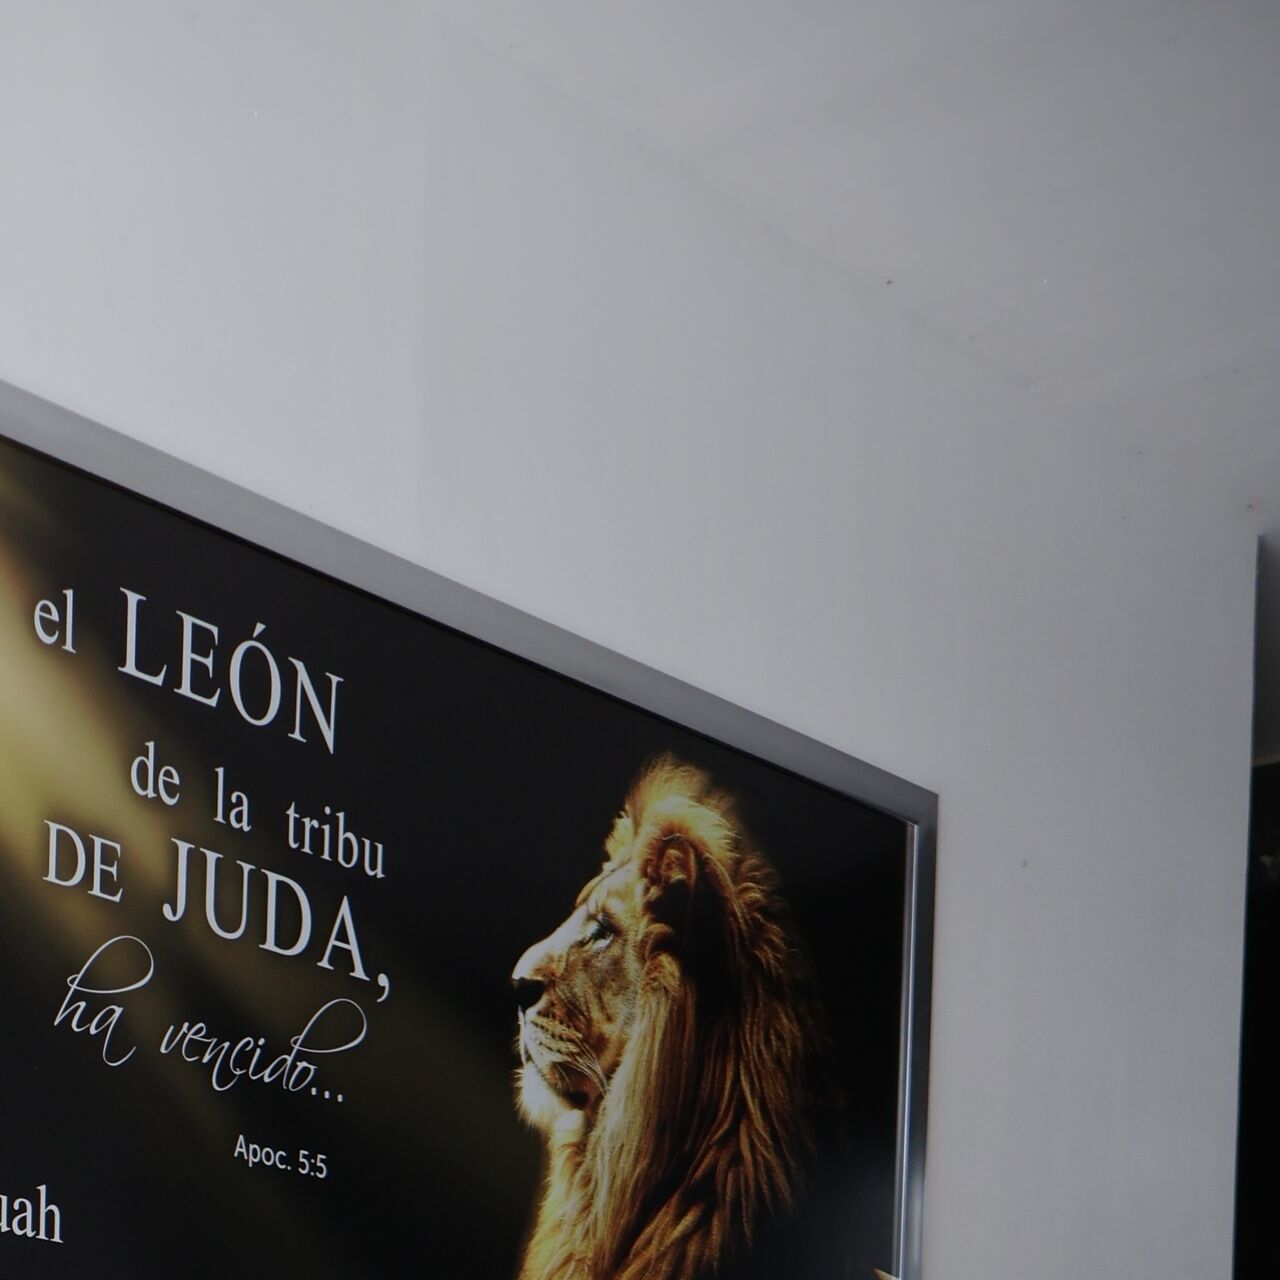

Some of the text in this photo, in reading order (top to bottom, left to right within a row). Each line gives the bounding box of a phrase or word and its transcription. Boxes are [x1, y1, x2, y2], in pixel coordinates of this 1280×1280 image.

[33, 586, 344, 754] el LEÓN
[130, 741, 385, 879] de la tribu
[42, 819, 390, 1003] DE JUDA,
[54, 935, 367, 1102] ha vencido...
[234, 1134, 327, 1178] Apoc. 5:5
